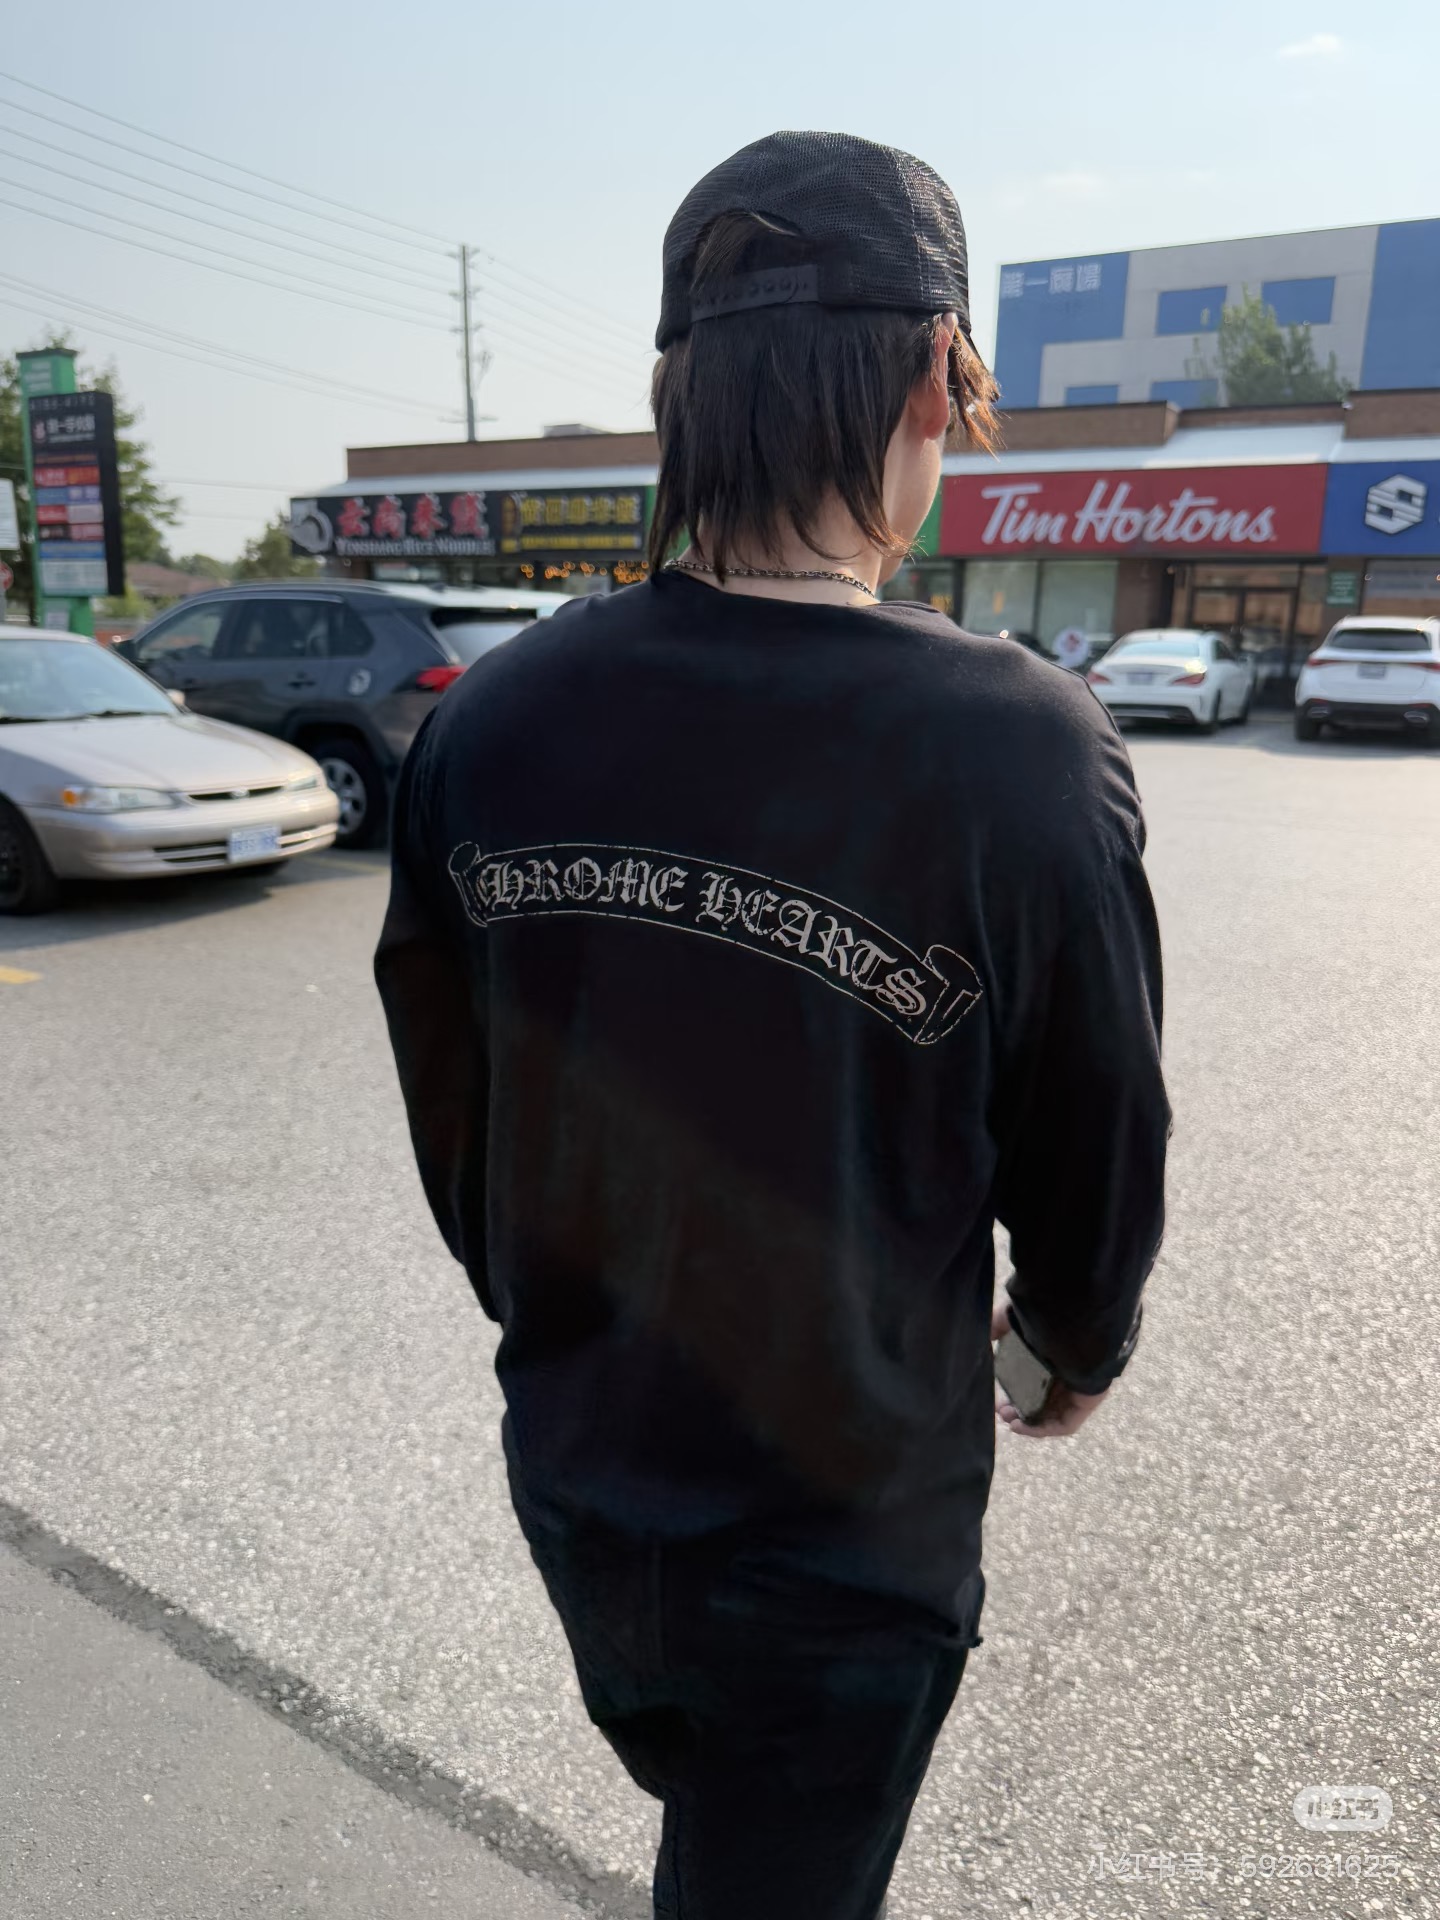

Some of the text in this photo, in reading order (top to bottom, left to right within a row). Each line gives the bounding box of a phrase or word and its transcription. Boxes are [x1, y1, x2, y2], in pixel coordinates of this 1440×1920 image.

[981, 478, 1276, 545] Tim Hortons
[476, 856, 928, 1016] CHROME HEARTS
